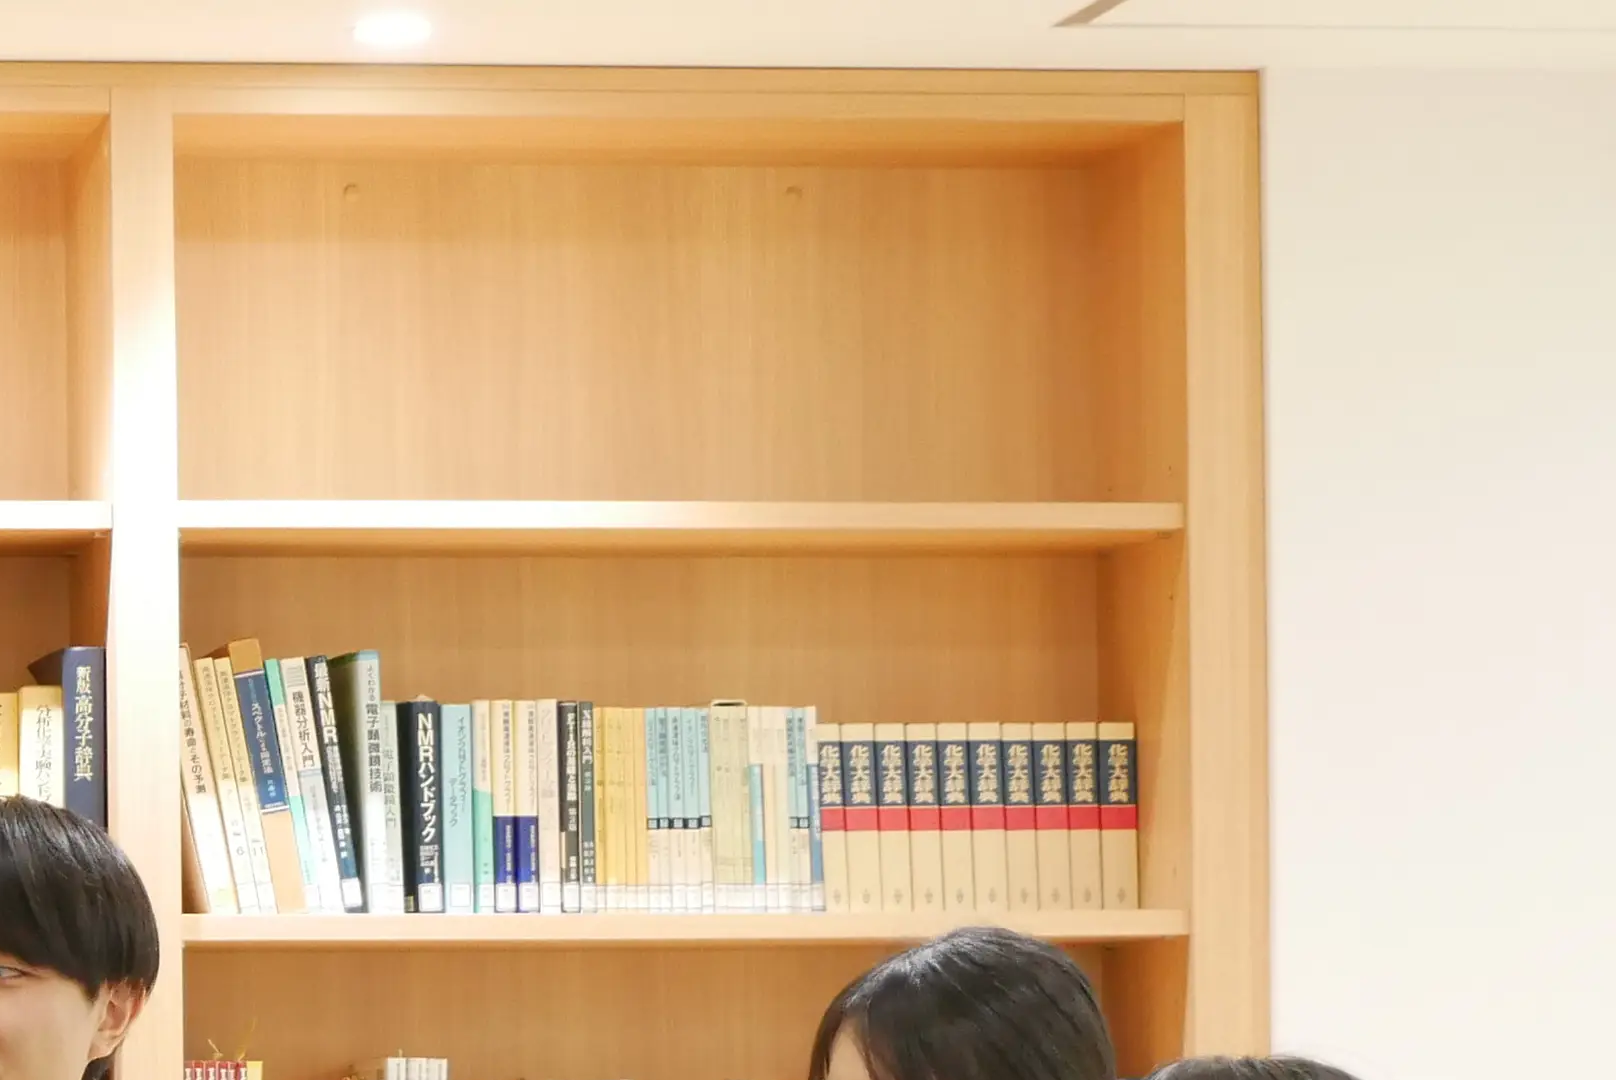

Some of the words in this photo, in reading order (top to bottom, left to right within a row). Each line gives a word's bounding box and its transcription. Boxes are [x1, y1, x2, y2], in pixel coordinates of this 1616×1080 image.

[290, 690, 316, 769] 機器分析入門
[417, 713, 436, 843] NMRハンドブック
